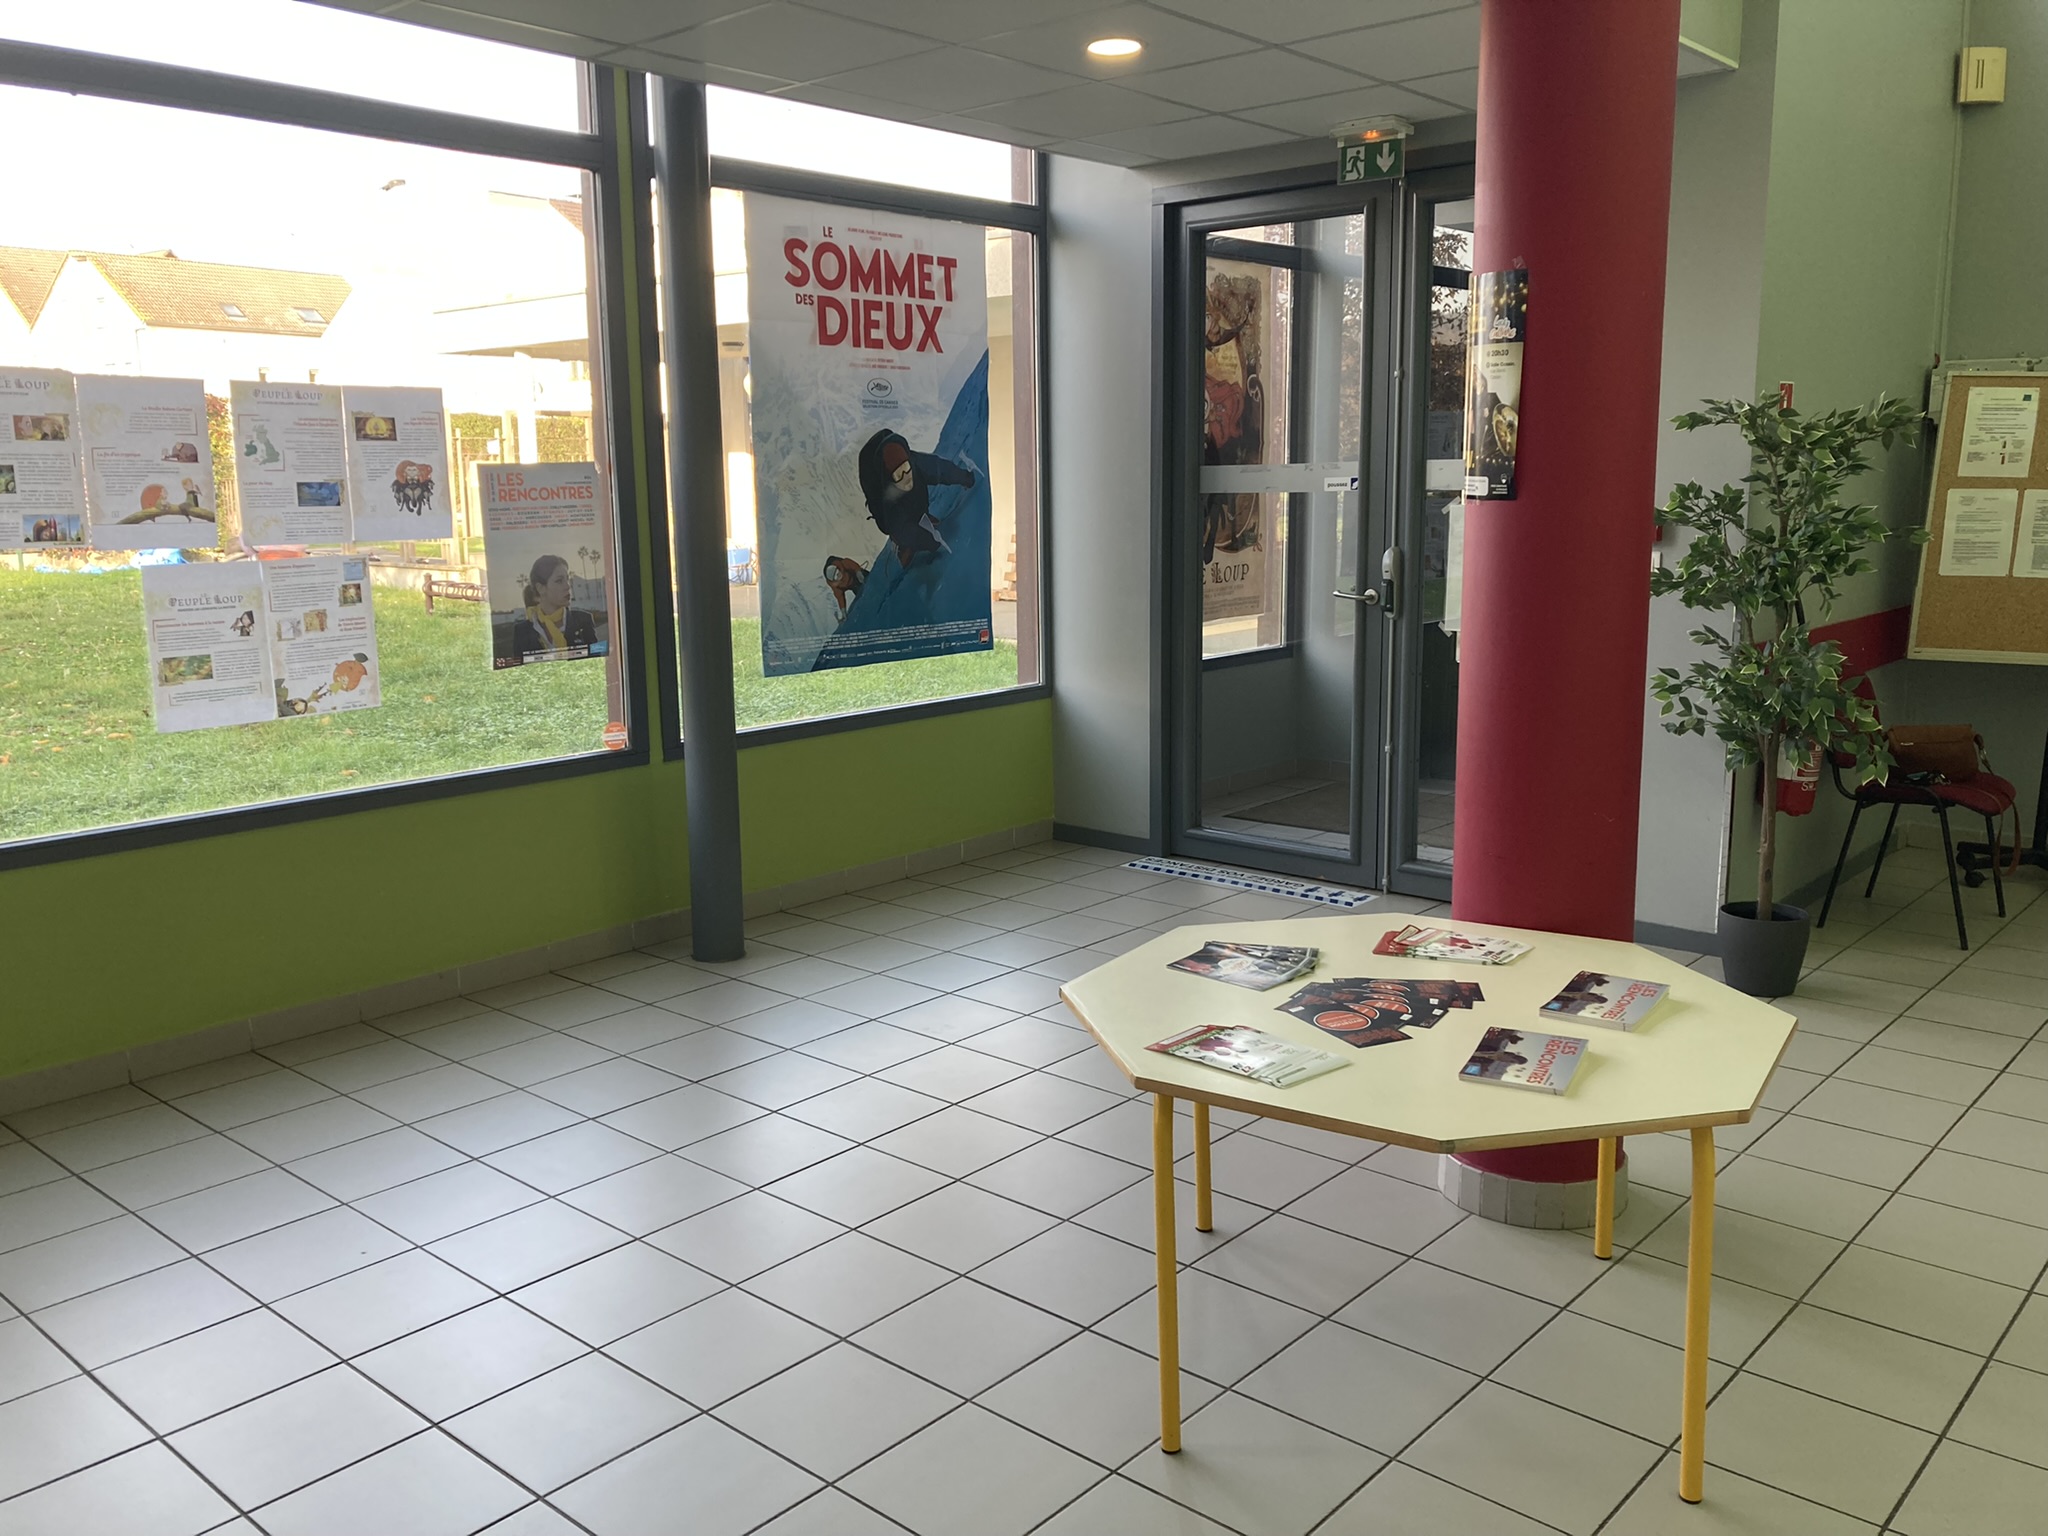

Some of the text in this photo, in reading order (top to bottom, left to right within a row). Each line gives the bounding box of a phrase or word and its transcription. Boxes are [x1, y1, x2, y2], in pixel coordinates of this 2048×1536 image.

[822, 226, 834, 238] LE
[783, 237, 958, 302] SOMMET
[795, 293, 814, 306] DES
[817, 295, 944, 354] DIEUX
[253, 388, 293, 399] PEUPLE
[496, 472, 524, 487] LES
[498, 485, 594, 503] RENCONTRES
[1210, 562, 1250, 584] LOUP
[168, 594, 244, 607] PEUPLE LOUP
[1145, 857, 1305, 888] GARDEZ VOS DISTANCES
[1601, 982, 1645, 1020] RENCONTRES
[1562, 1039, 1579, 1056] LES
[1525, 1037, 1563, 1085] RENCONTRES
